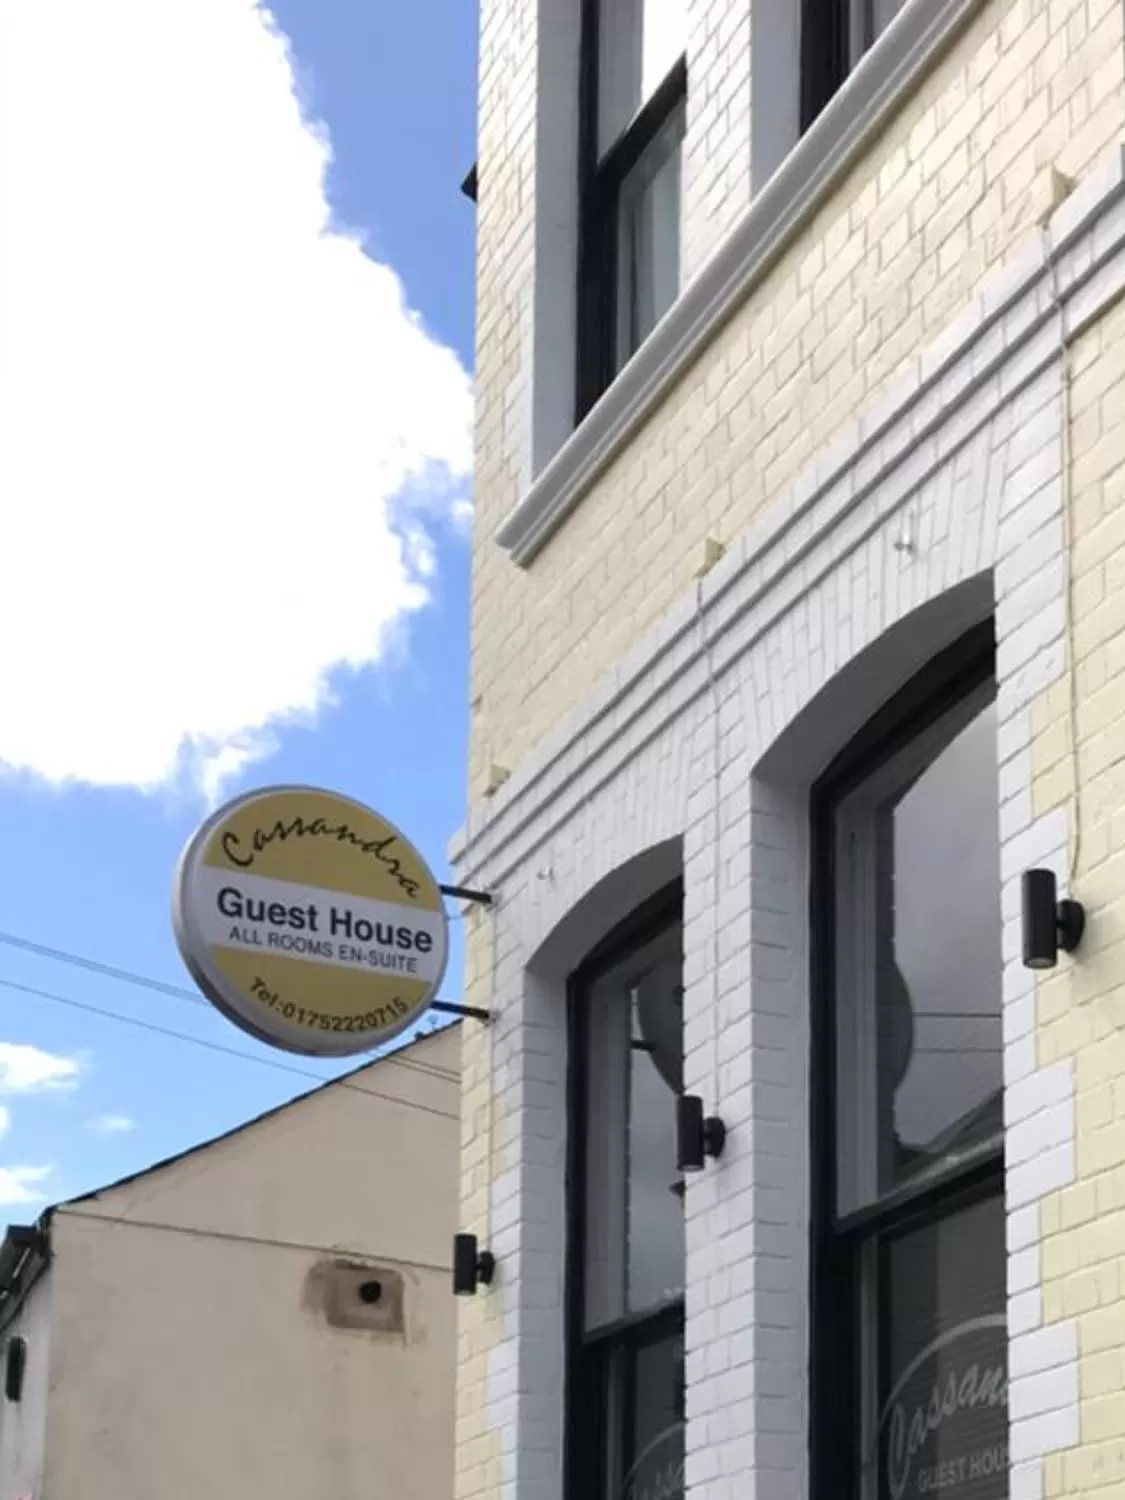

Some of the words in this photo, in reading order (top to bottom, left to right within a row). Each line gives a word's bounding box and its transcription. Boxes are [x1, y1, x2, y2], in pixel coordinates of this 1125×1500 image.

[221, 817, 421, 898] Cassandra
[217, 887, 318, 932] Guest
[330, 907, 433, 952] House
[228, 926, 262, 945] ALL
[267, 934, 333, 959] ROOMS
[338, 944, 418, 973] EN-SUITE
[969, 1444, 1008, 1479] HOU
